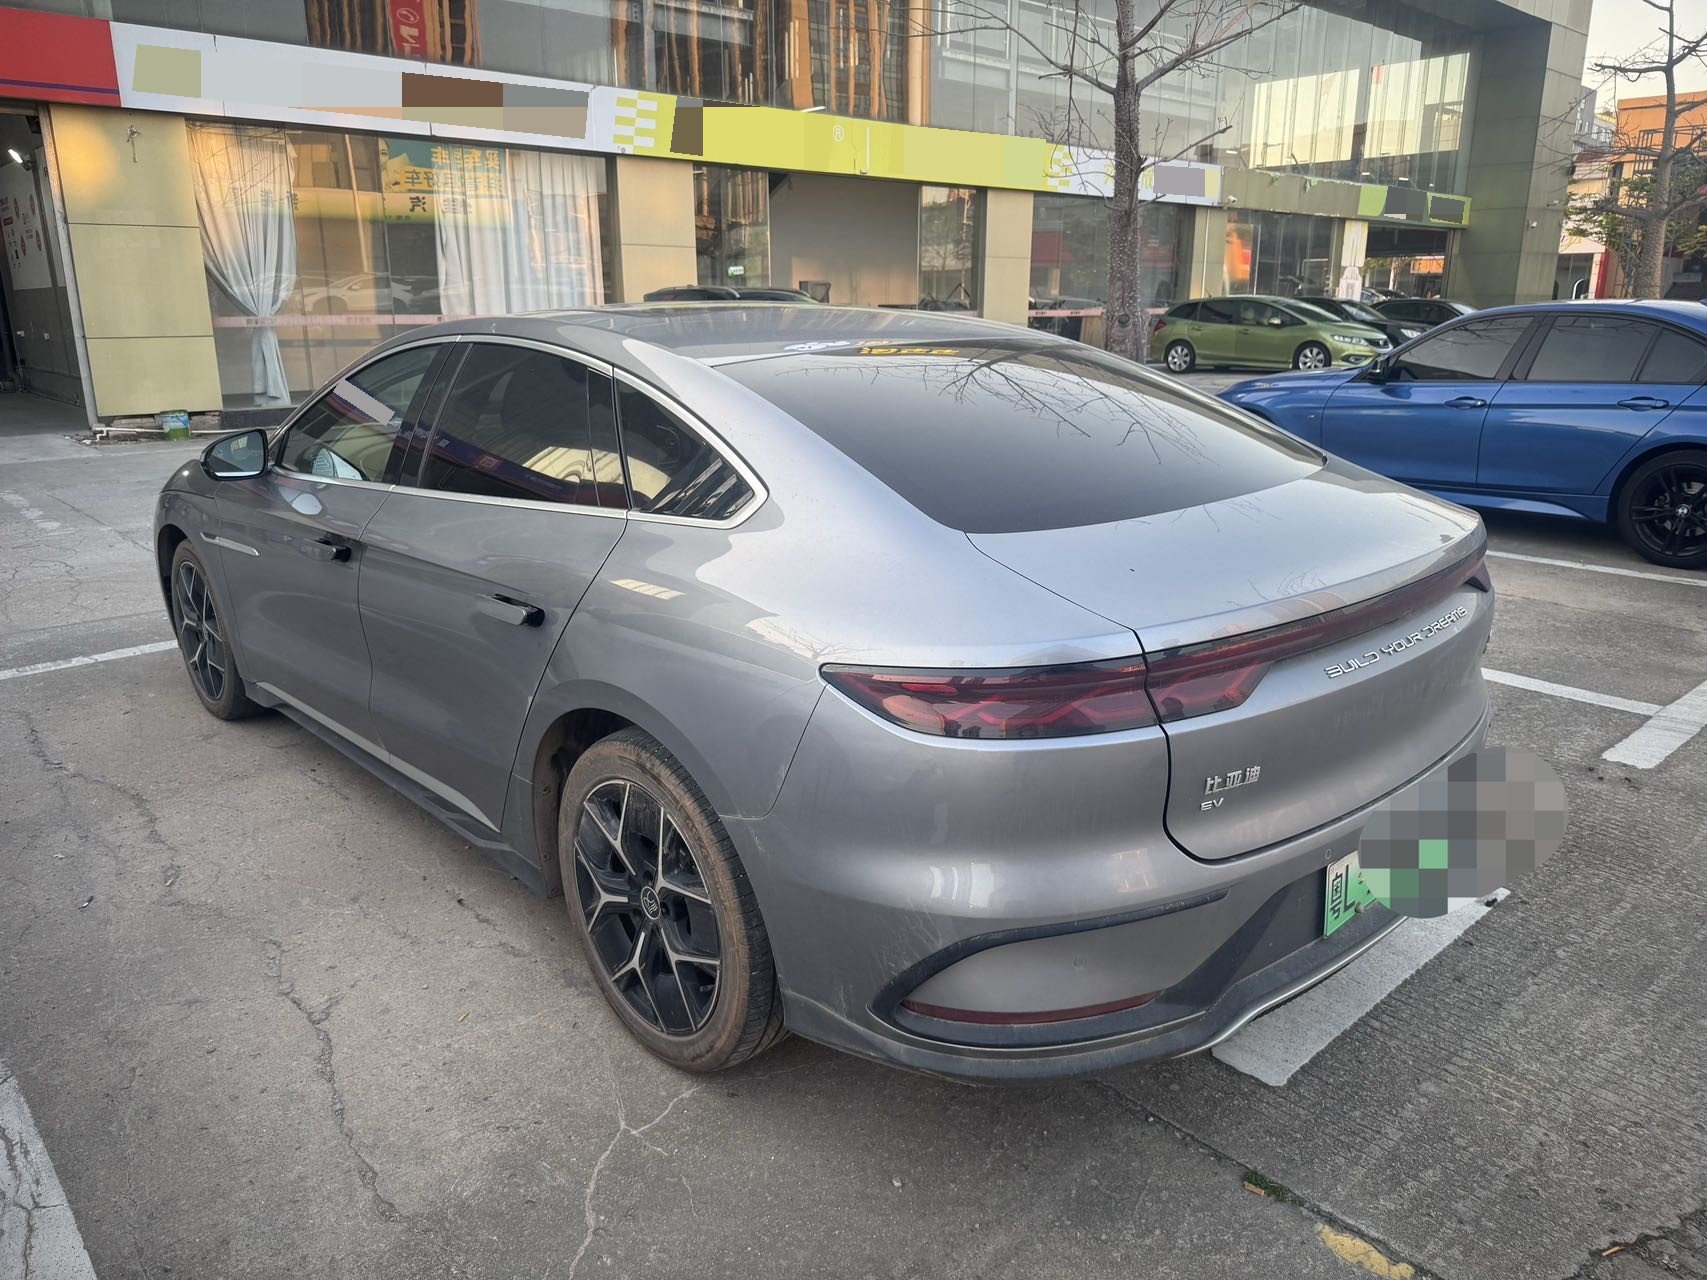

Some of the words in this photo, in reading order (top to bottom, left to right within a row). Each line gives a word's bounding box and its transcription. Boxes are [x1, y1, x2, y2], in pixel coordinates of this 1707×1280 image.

[1325, 651, 1380, 678] BUILD
[1381, 632, 1423, 655] YOUR
[1421, 606, 1467, 638] DREAMS
[1204, 765, 1261, 795] 比亚迪
[1200, 797, 1224, 811] EV
